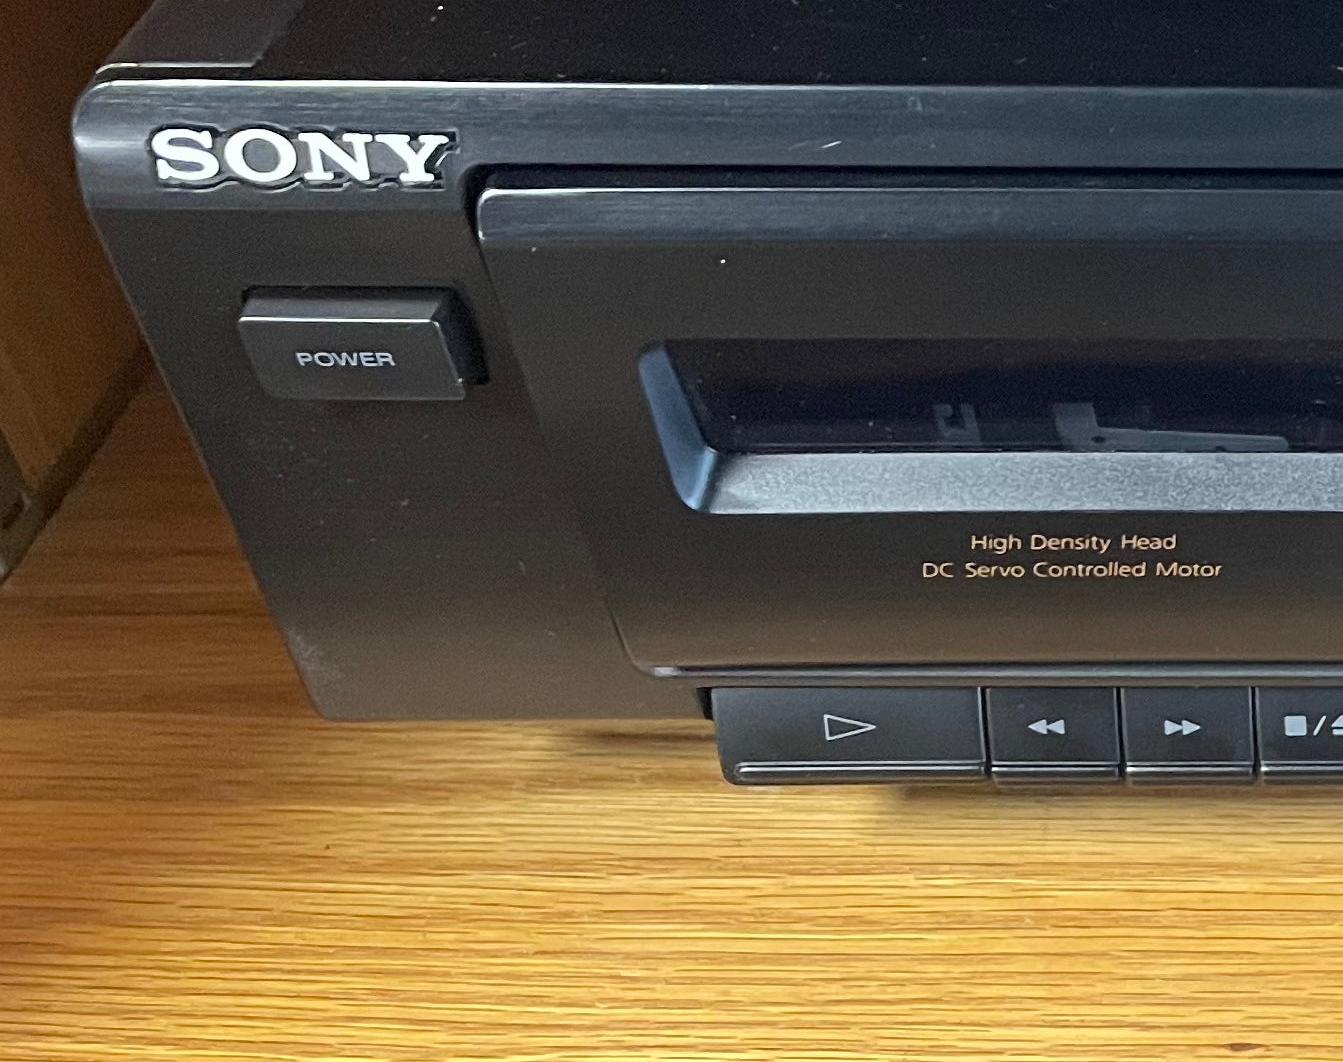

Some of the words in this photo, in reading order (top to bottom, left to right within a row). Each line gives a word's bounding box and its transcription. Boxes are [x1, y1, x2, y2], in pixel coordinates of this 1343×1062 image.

[151, 128, 450, 182] SONY
[296, 352, 396, 367] POWER
[970, 534, 1022, 553] High
[1030, 534, 1112, 553] Density
[1121, 534, 1177, 550] Head
[922, 562, 955, 579] DC
[965, 562, 1026, 579] Servo
[1032, 561, 1146, 578] Controlled
[1156, 561, 1223, 578] Motor
